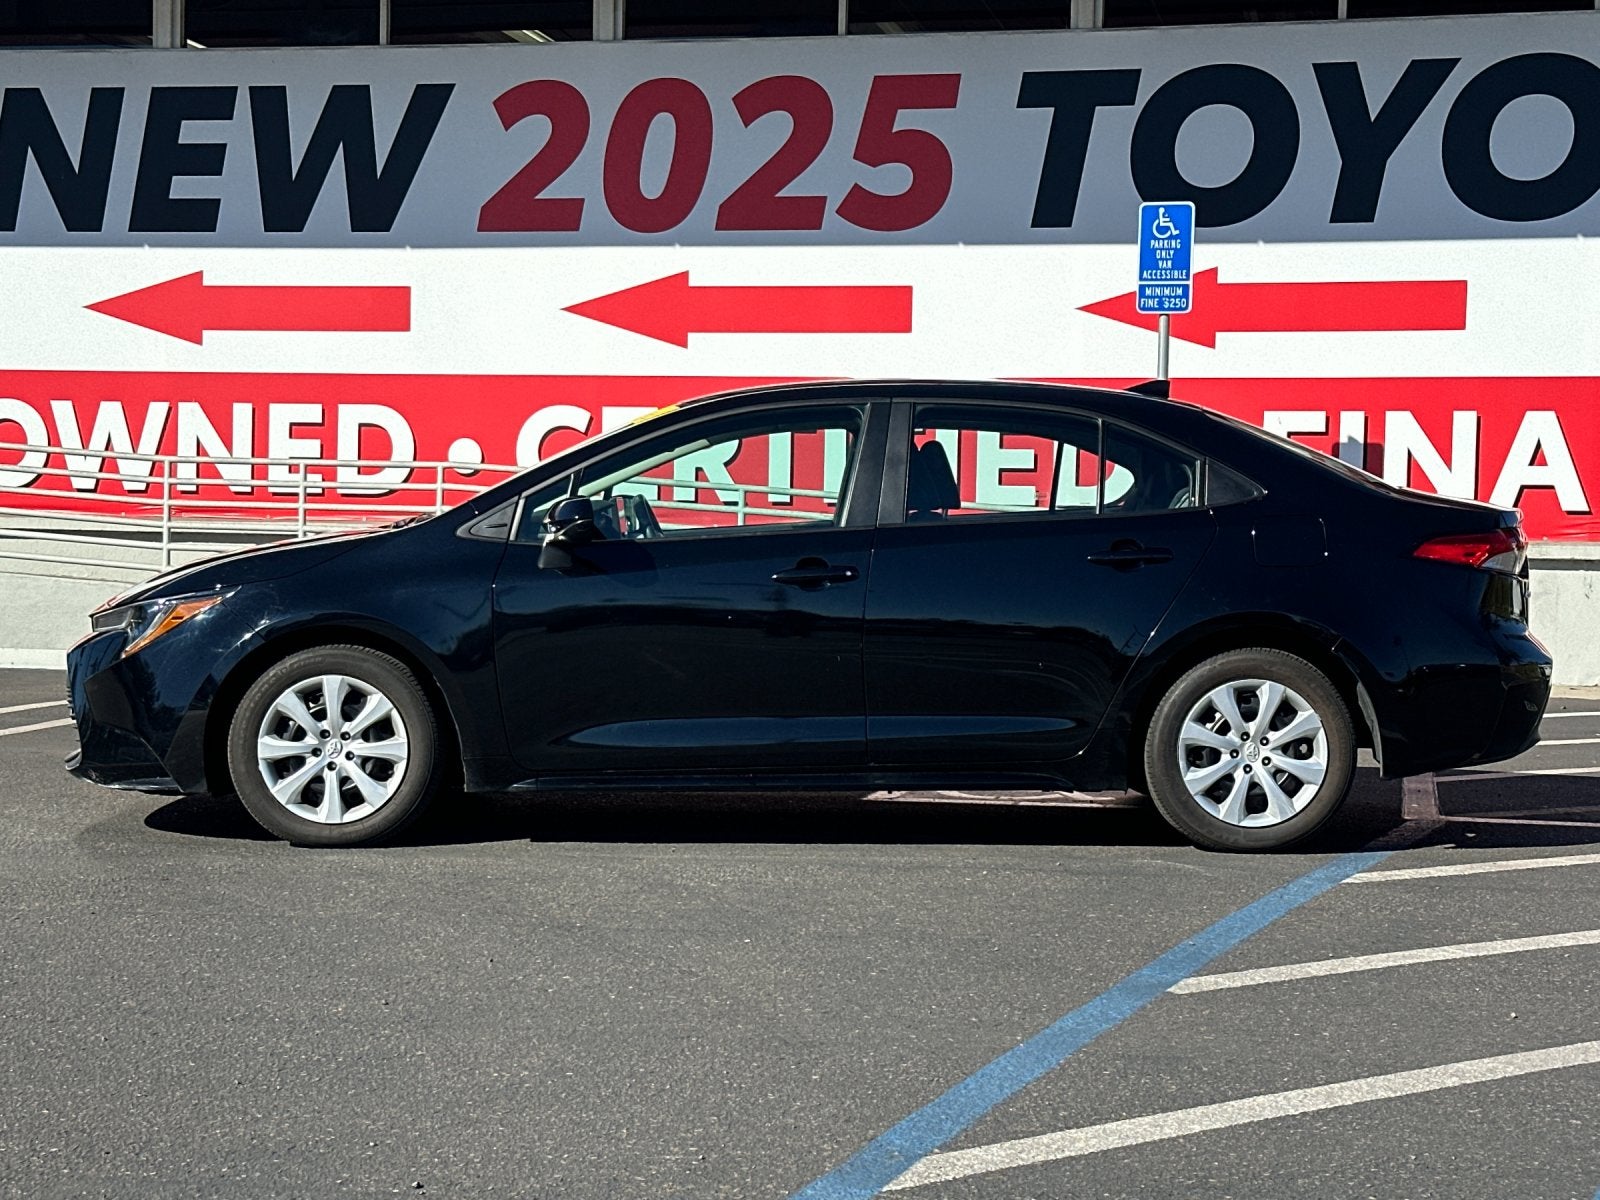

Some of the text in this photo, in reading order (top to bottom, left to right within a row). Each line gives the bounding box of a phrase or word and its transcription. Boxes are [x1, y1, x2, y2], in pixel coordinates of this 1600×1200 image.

[0, 52, 1600, 234] NEW 2025 TOYO
[1150, 239, 1181, 249] PARKING
[1156, 249, 1174, 259] ONLY
[1158, 260, 1172, 269] VAN
[1142, 270, 1187, 279] ACCESSIBLE
[1145, 286, 1183, 296] MINIMUM
[1140, 298, 1187, 309] FINE $250
